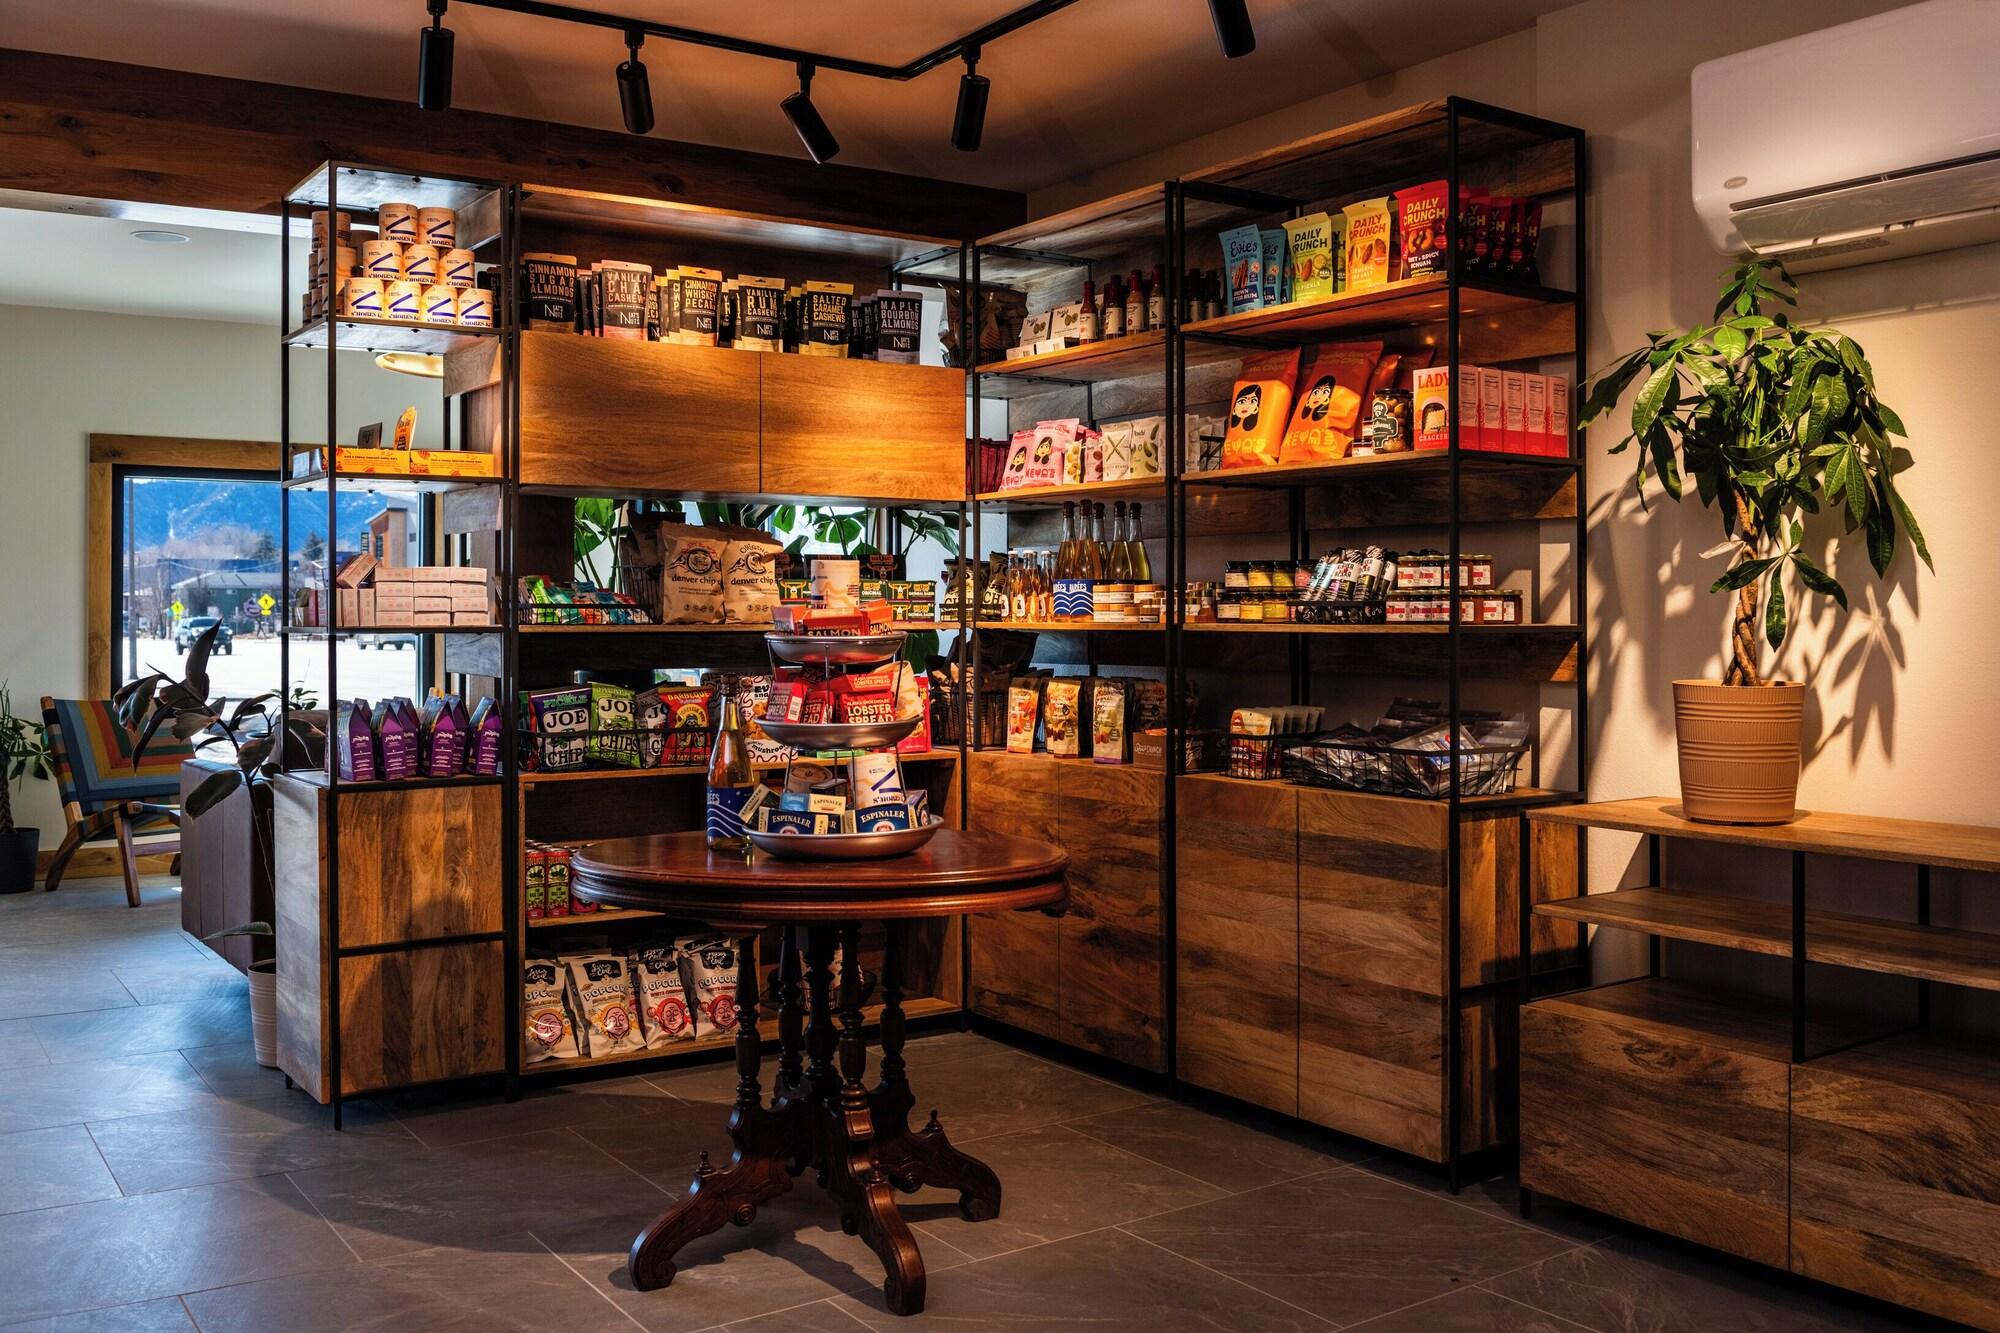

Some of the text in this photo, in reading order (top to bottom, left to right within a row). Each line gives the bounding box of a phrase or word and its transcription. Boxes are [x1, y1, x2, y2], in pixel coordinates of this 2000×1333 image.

[1407, 197, 1439, 214] DAILY
[1353, 213, 1383, 229] DAILY
[1294, 227, 1322, 243] DAILY
[1230, 240, 1258, 257] Evie's
[528, 263, 575, 278] CINNAMON
[529, 273, 575, 288] SUGAR
[607, 271, 647, 284] VANILLA
[530, 283, 575, 298] ALMONDS
[607, 280, 646, 297] CHAI
[685, 288, 717, 301] WHISKEY
[813, 294, 847, 306] SALTED
[880, 300, 920, 312] MAPLE
[813, 303, 845, 315] CARAMEL
[881, 309, 919, 322] BOURBON
[813, 311, 846, 324] CASHEWS
[881, 318, 919, 330] ALMONDS
[1418, 372, 1449, 389] LADY
[1224, 437, 1268, 456] EYA'S
[671, 574, 698, 584] denver
[699, 575, 717, 586] chip
[730, 575, 774, 587] denver chip
[869, 622, 892, 634] SALMON
[647, 703, 668, 719] JO
[804, 703, 822, 714] STER
[847, 703, 893, 717] LOBSTER
[546, 709, 588, 729] JOE
[848, 713, 894, 724] SPREAD
[599, 734, 640, 753] CHIPS
[813, 798, 842, 807] ESPINALER
[772, 815, 811, 828] ESPINALER
[860, 810, 905, 823] ESPINALER
[642, 978, 682, 993] POPCOR
[699, 975, 737, 988] POPCOR
[584, 983, 625, 1001] POPCOR
